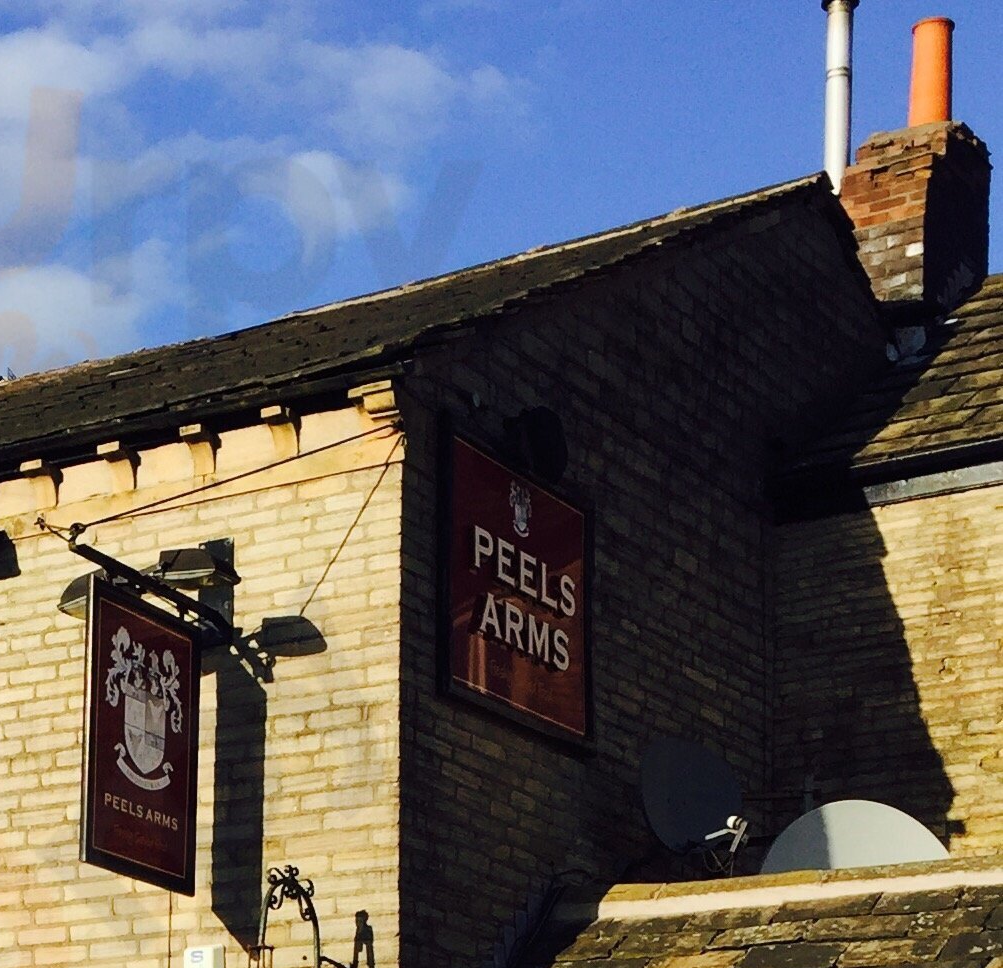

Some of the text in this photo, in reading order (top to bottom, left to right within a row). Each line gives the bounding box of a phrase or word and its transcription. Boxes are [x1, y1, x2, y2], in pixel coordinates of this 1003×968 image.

[473, 524, 576, 617] PEELS
[479, 592, 570, 671] ARMS
[104, 792, 179, 832] PEELS ARMS
